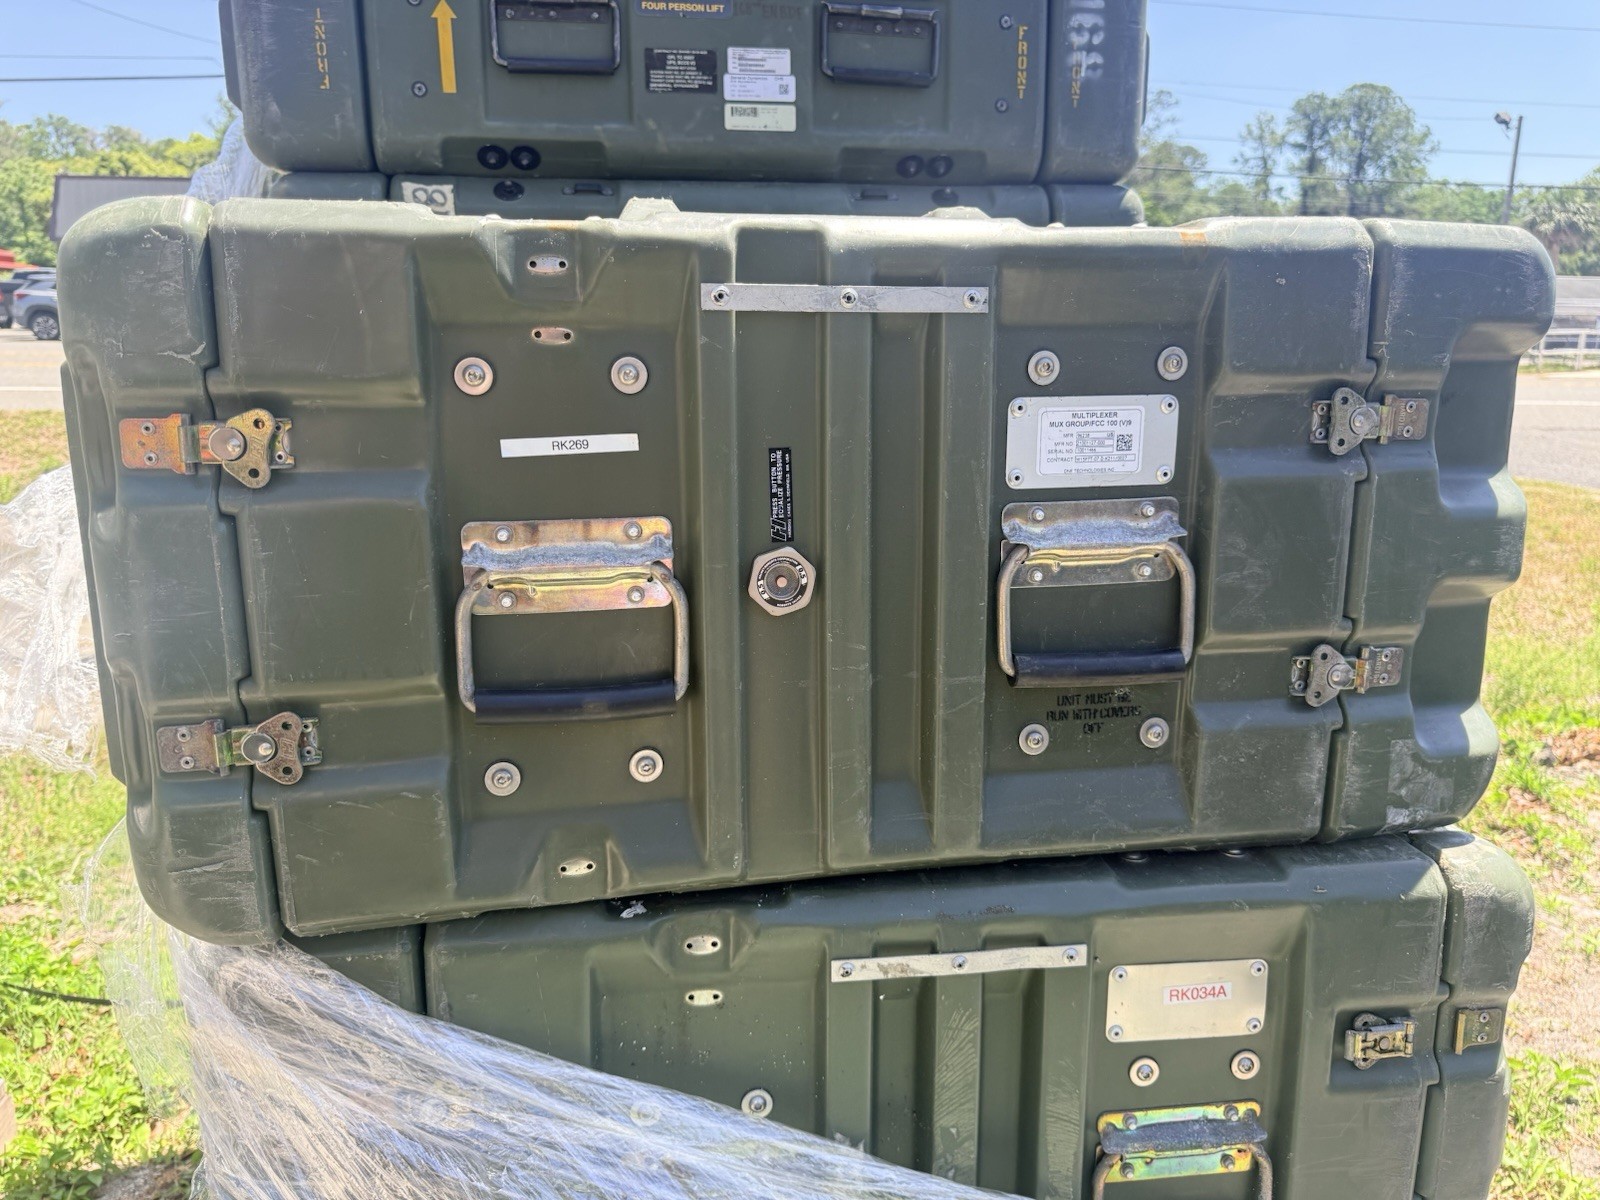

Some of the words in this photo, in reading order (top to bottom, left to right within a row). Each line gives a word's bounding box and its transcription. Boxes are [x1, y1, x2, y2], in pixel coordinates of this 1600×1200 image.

[642, 2, 666, 11] FOUR
[668, 3, 704, 12] PERSON
[706, 4, 725, 13] LIFT
[1018, 24, 1028, 99] FRONT
[552, 439, 589, 451] RK269
[771, 453, 776, 462] TO
[1057, 694, 1081, 706] UNIT
[1085, 692, 1114, 705] MUST
[1046, 710, 1069, 721] RUN
[1073, 709, 1097, 720] WITH
[1100, 705, 1142, 718] COVERS
[1083, 722, 1104, 734] OFF
[1170, 985, 1227, 1002] RK034A
